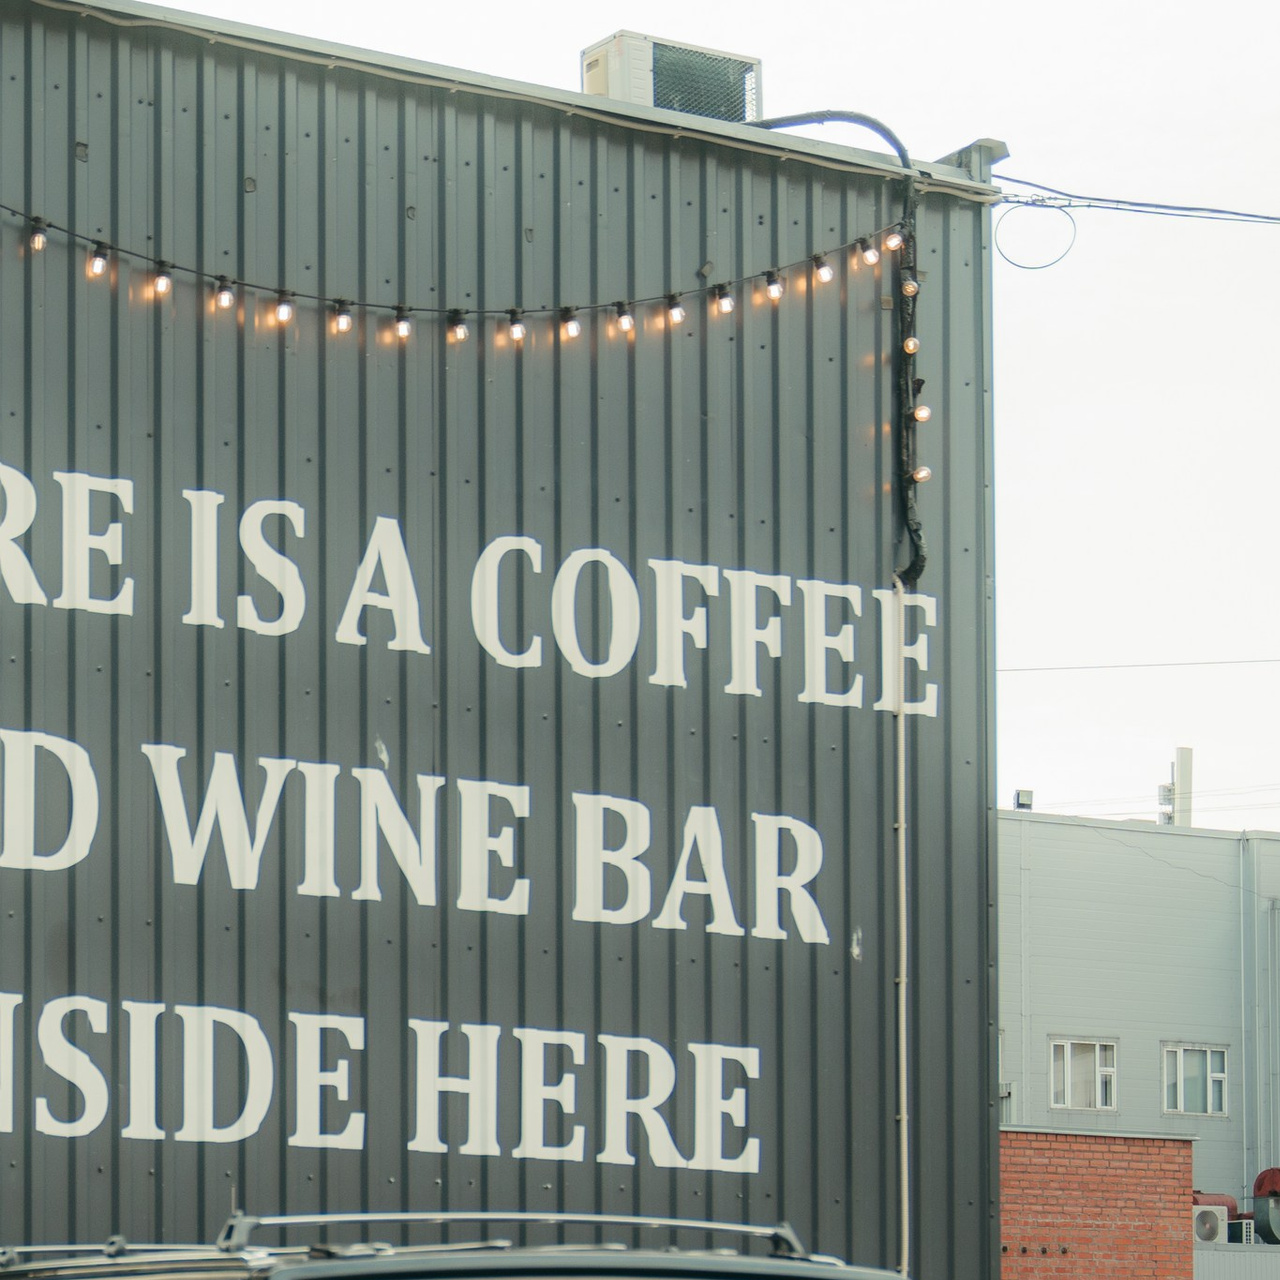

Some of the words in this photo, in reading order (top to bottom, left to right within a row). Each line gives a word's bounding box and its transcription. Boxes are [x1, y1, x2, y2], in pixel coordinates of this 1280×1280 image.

[183, 489, 306, 637] IS
[336, 515, 431, 655] A
[470, 535, 938, 718] COFFEE
[140, 743, 531, 916] WINE
[571, 792, 830, 945] BAR
[407, 1018, 760, 1174] HERE
